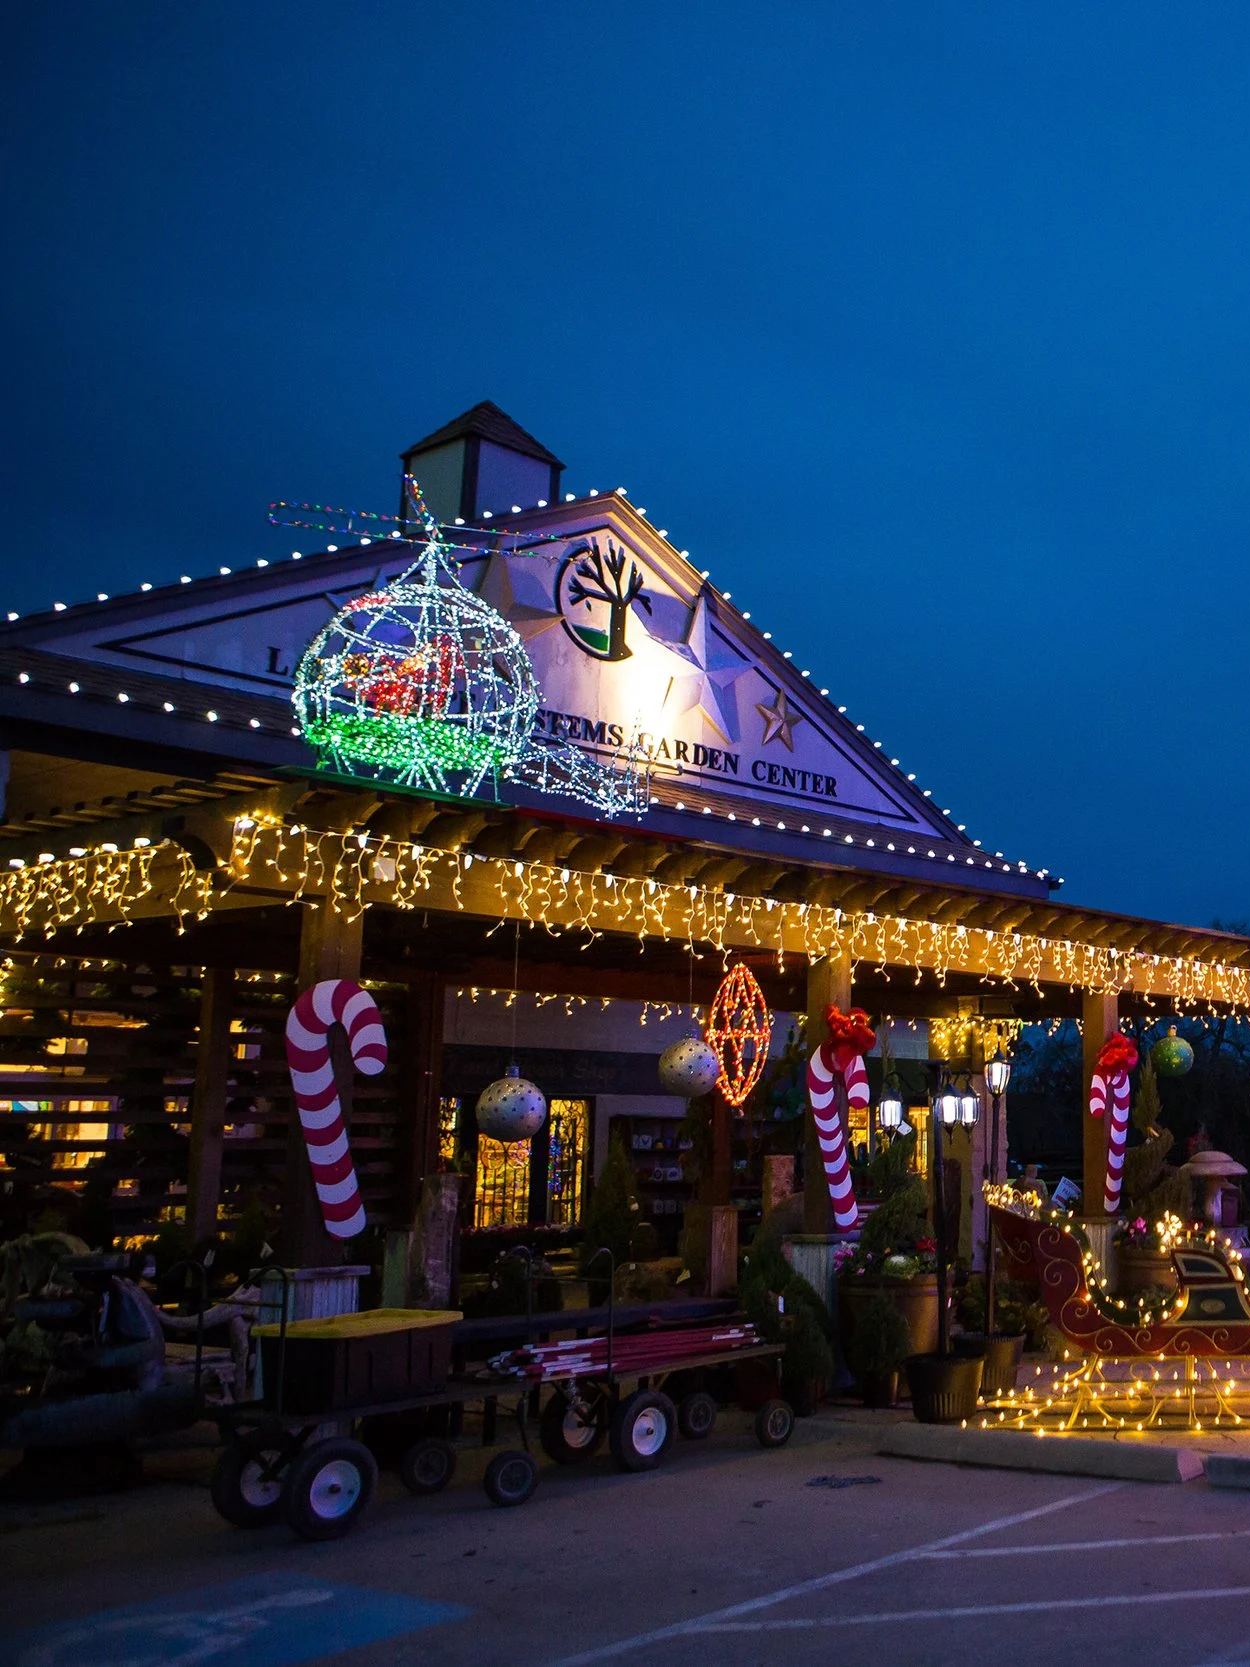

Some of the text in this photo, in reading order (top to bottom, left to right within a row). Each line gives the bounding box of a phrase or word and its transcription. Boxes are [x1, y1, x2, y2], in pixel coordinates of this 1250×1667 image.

[532, 708, 838, 798] STEMS GARDEN CENTER
